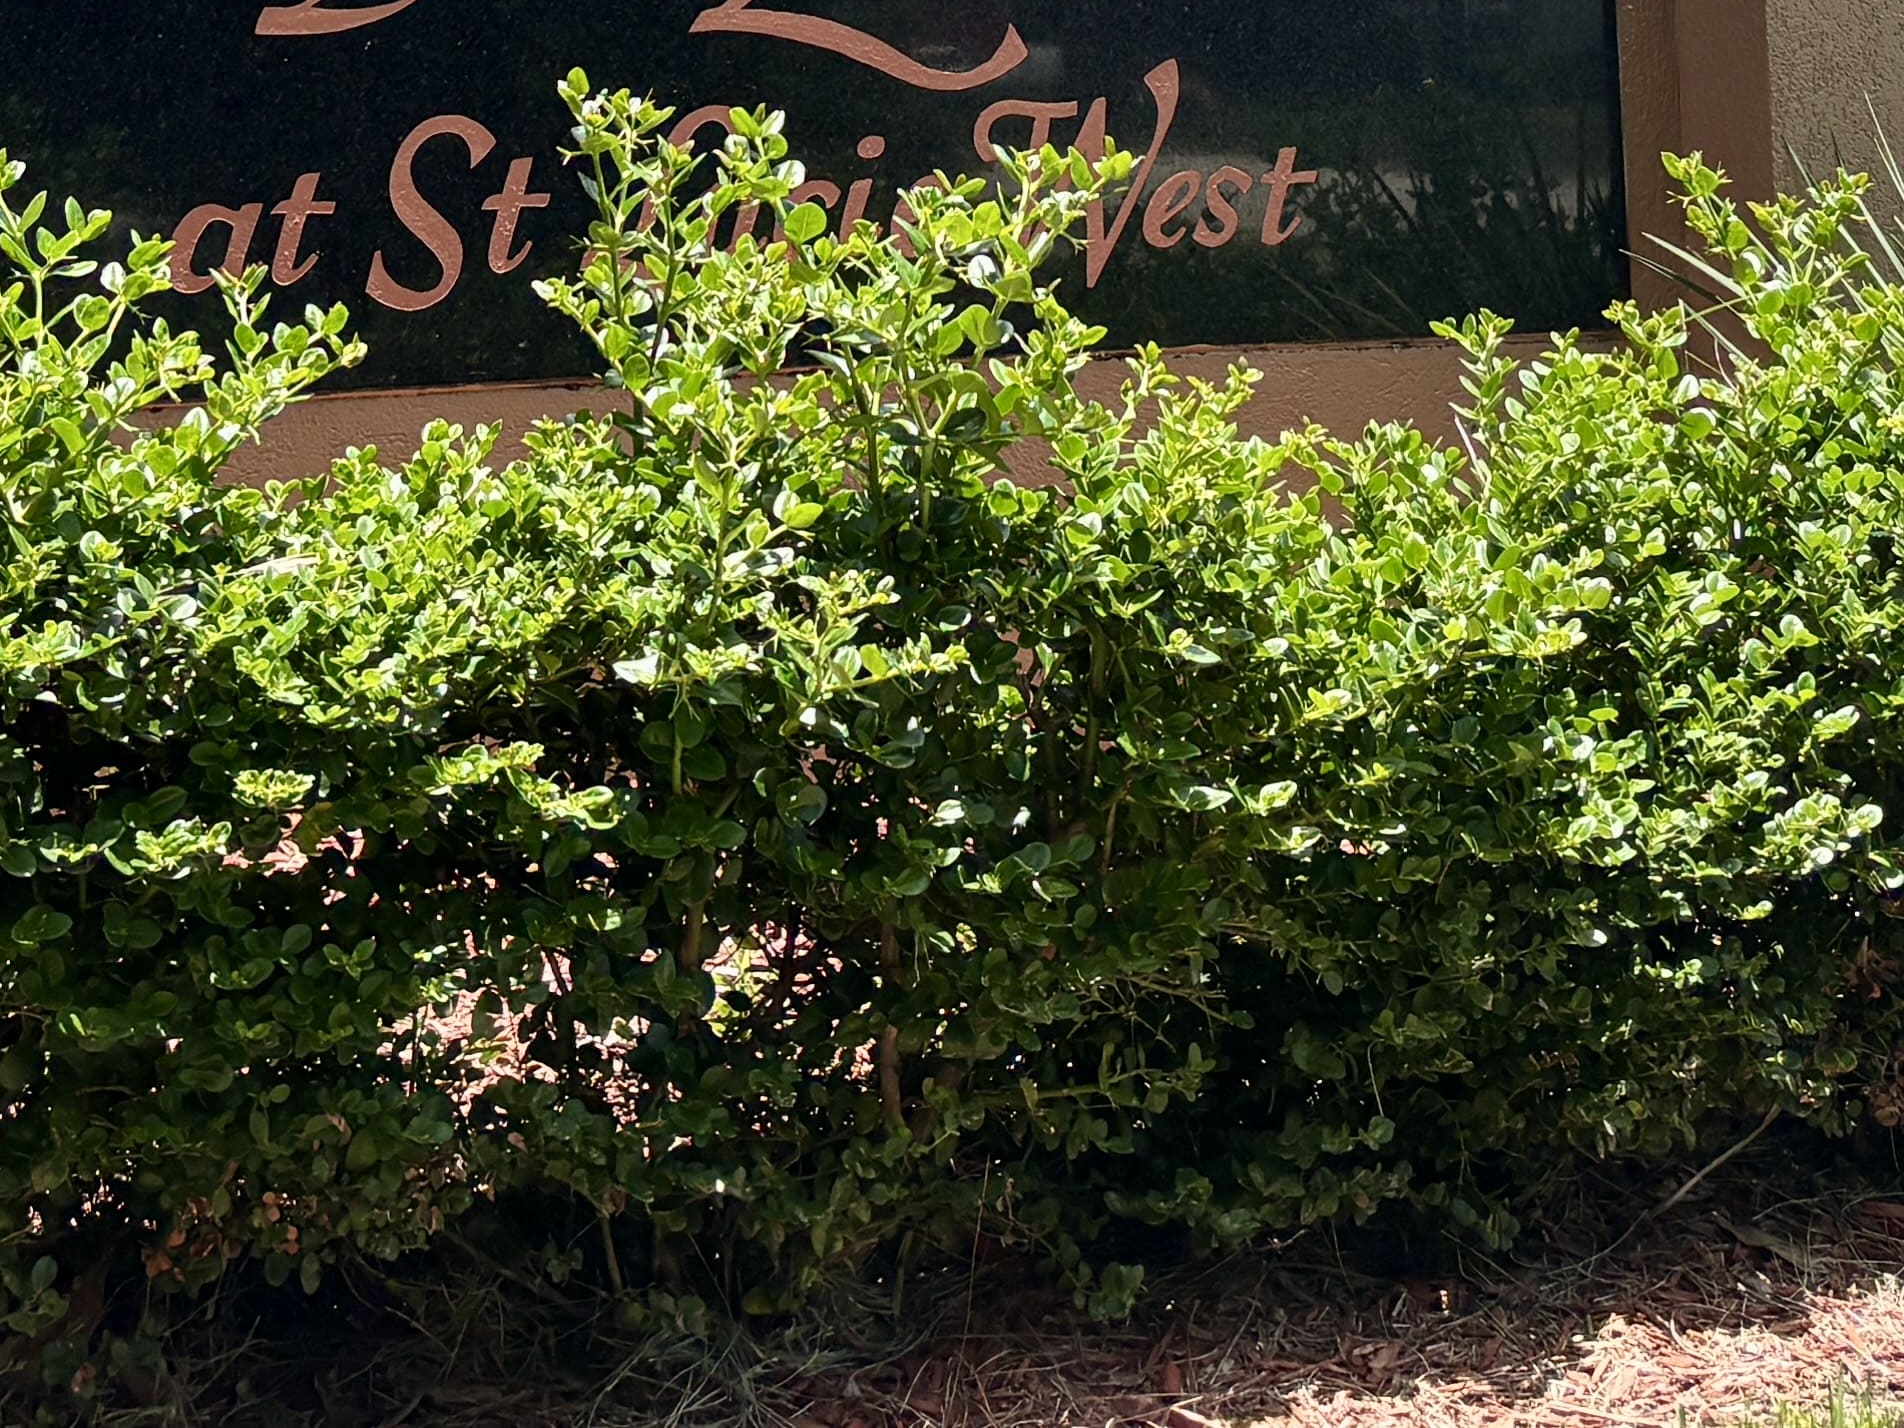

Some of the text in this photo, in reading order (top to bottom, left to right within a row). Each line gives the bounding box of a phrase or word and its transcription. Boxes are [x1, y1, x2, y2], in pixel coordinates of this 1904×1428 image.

[170, 172, 337, 294] at
[365, 114, 551, 312] St
[973, 58, 1317, 288] West
